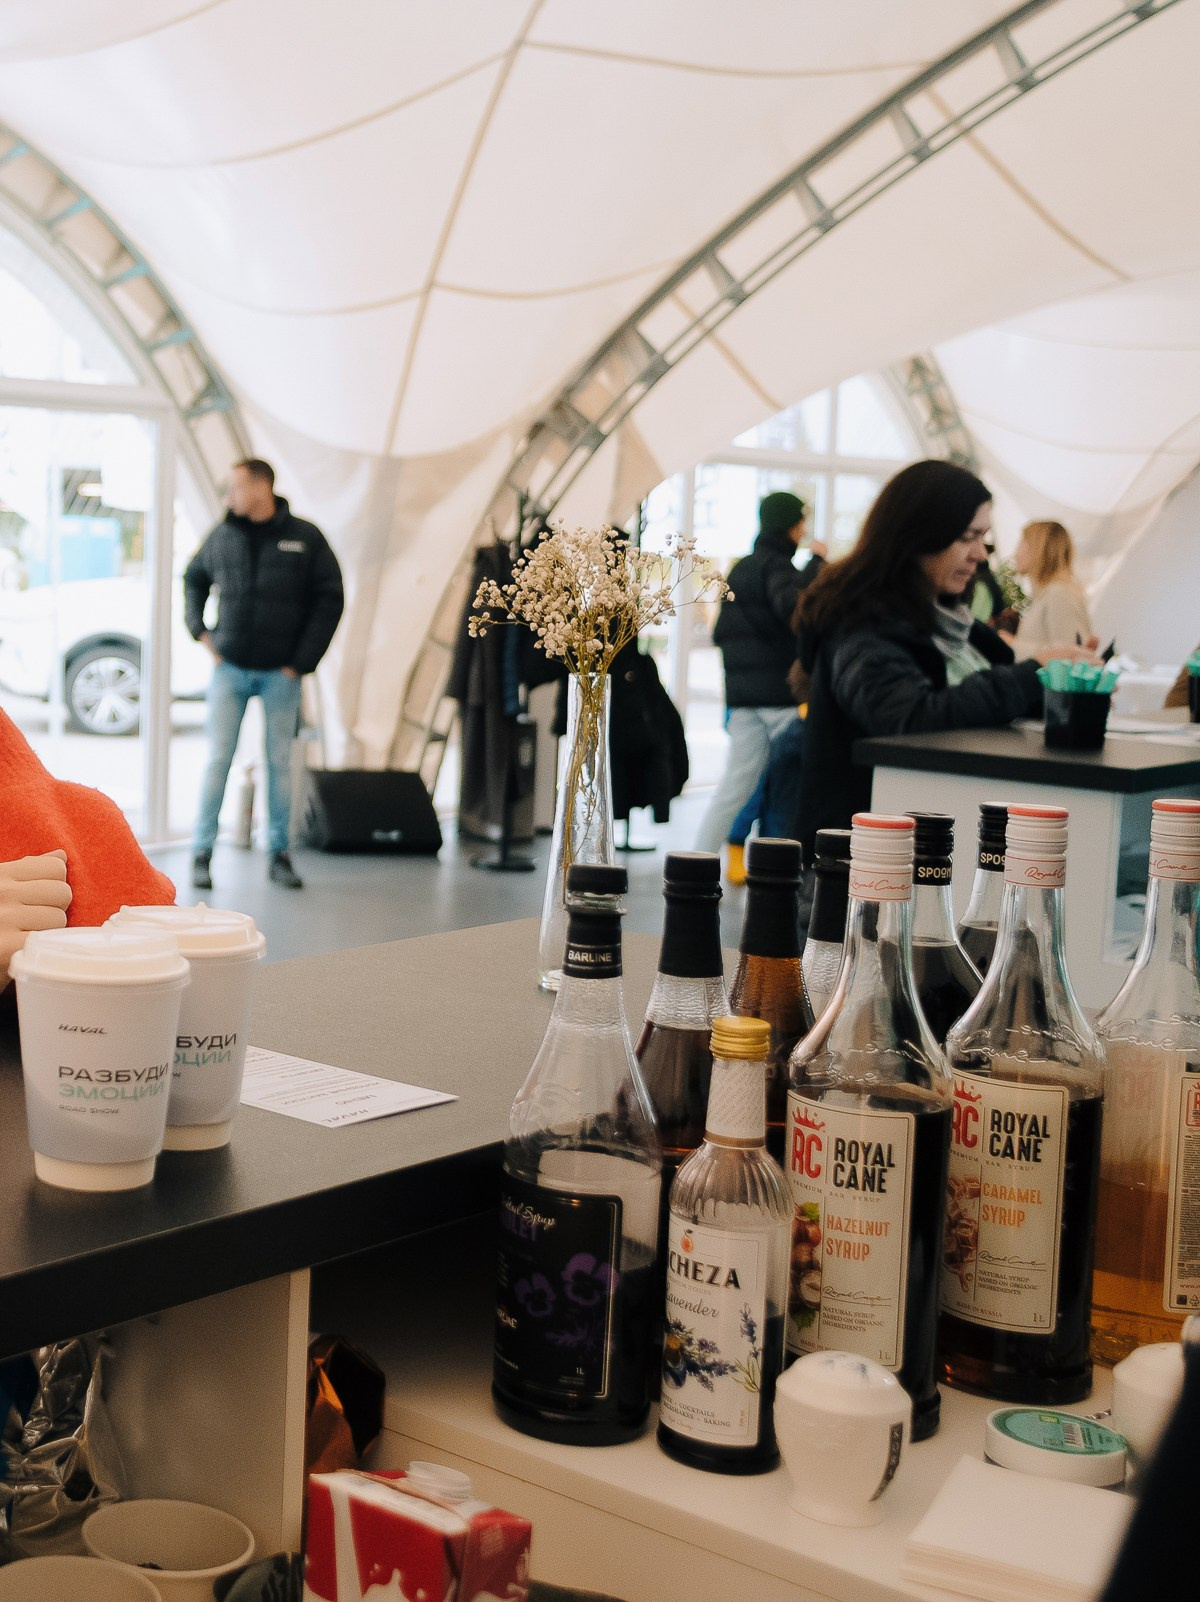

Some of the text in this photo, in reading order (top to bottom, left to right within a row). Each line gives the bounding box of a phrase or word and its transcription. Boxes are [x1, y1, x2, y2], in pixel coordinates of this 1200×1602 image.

[568, 948, 612, 964] BARLINE
[58, 1023, 108, 1035] HAVAL
[58, 1062, 169, 1083] РАЗБУДИ
[59, 1080, 166, 1102] ЭМОЦИИ
[58, 1104, 119, 1115] ROAD SHOW
[320, 1108, 369, 1123] HAVAL
[990, 1108, 1050, 1139] ROYAL
[791, 1126, 822, 1179] RC
[834, 1137, 896, 1168] ROYAL
[989, 1133, 1043, 1163] CANE
[833, 1161, 888, 1194] CANE
[982, 1181, 1043, 1205] CARAMEL
[826, 1214, 890, 1238] HAZELNUT
[982, 1204, 1026, 1228] SYRUP
[826, 1237, 870, 1261] SYRUP
[823, 1305, 852, 1318] NATURAL
[575, 1366, 585, 1375] 1L
[679, 1402, 715, 1418] COCKTAILS
[703, 1418, 731, 1428] BAKING
